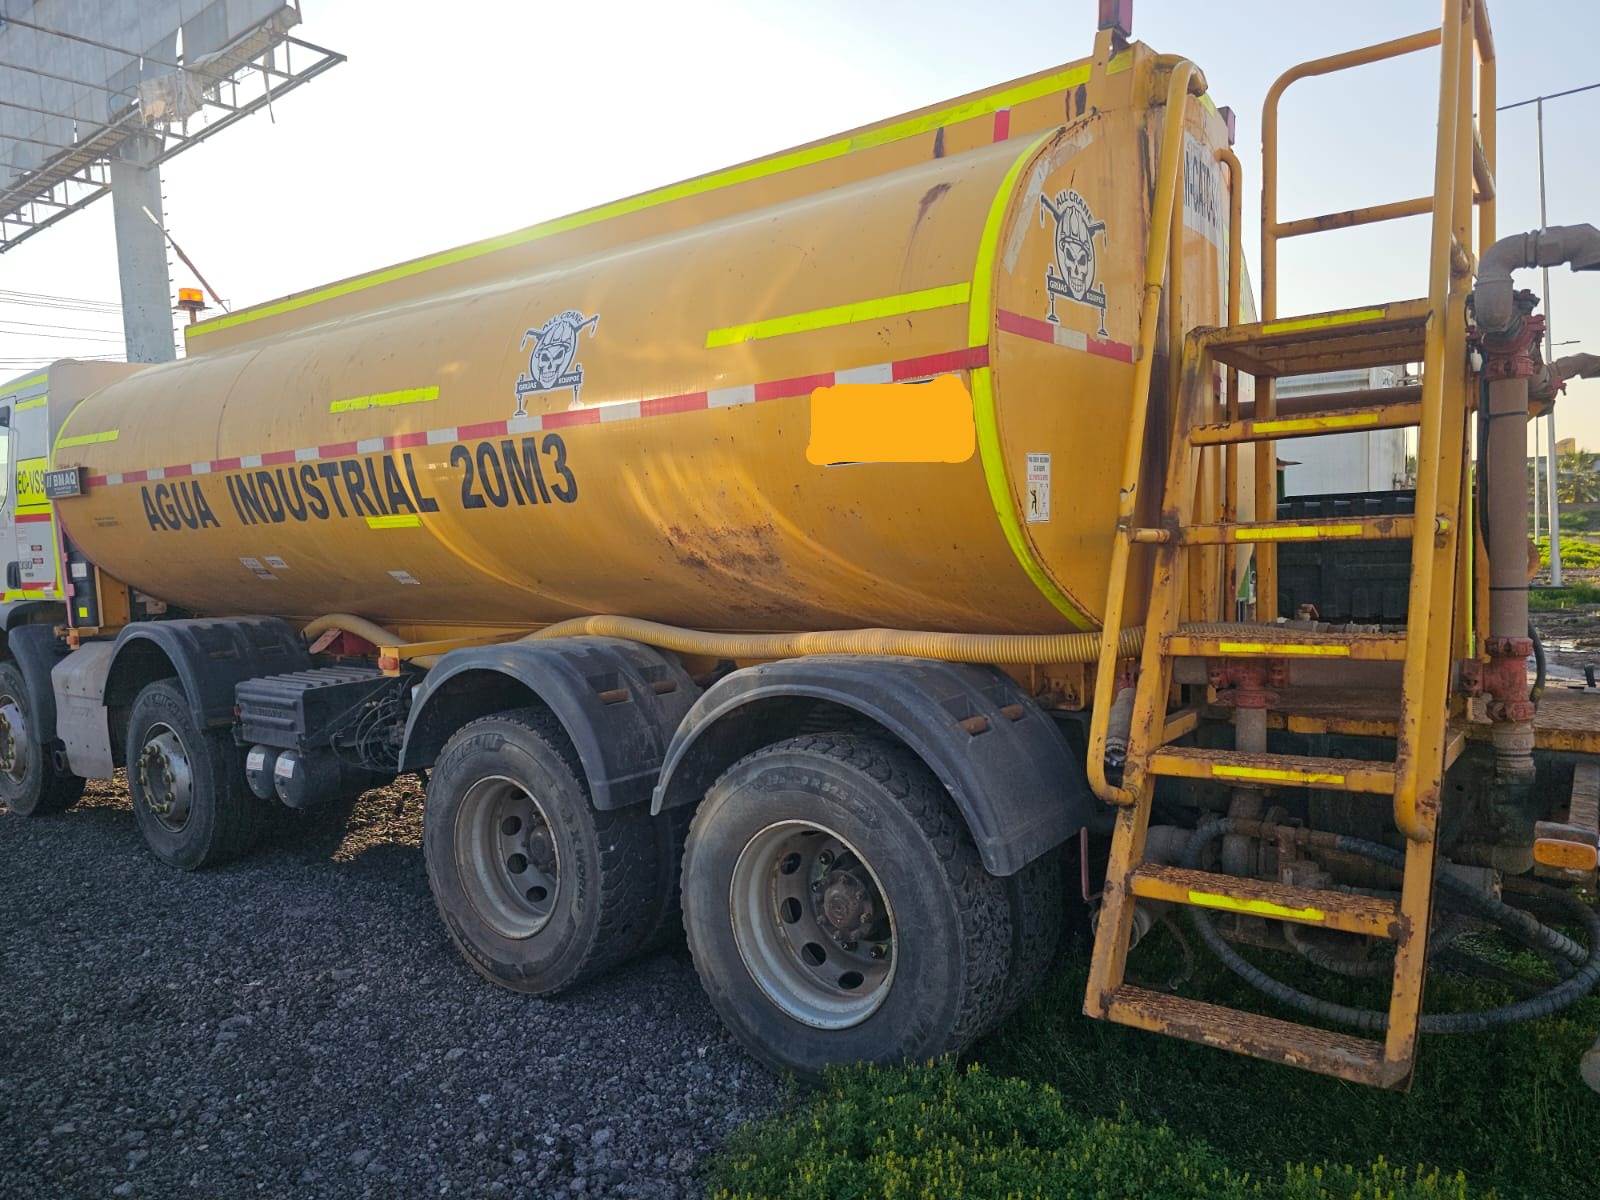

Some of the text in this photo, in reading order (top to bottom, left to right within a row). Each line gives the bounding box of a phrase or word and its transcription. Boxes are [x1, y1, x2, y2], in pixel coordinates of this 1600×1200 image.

[1056, 191, 1093, 221] ALL CRANE
[542, 311, 584, 332] ALL CRANE
[141, 433, 578, 532] AGUA INDUSTRIAL 20M3
